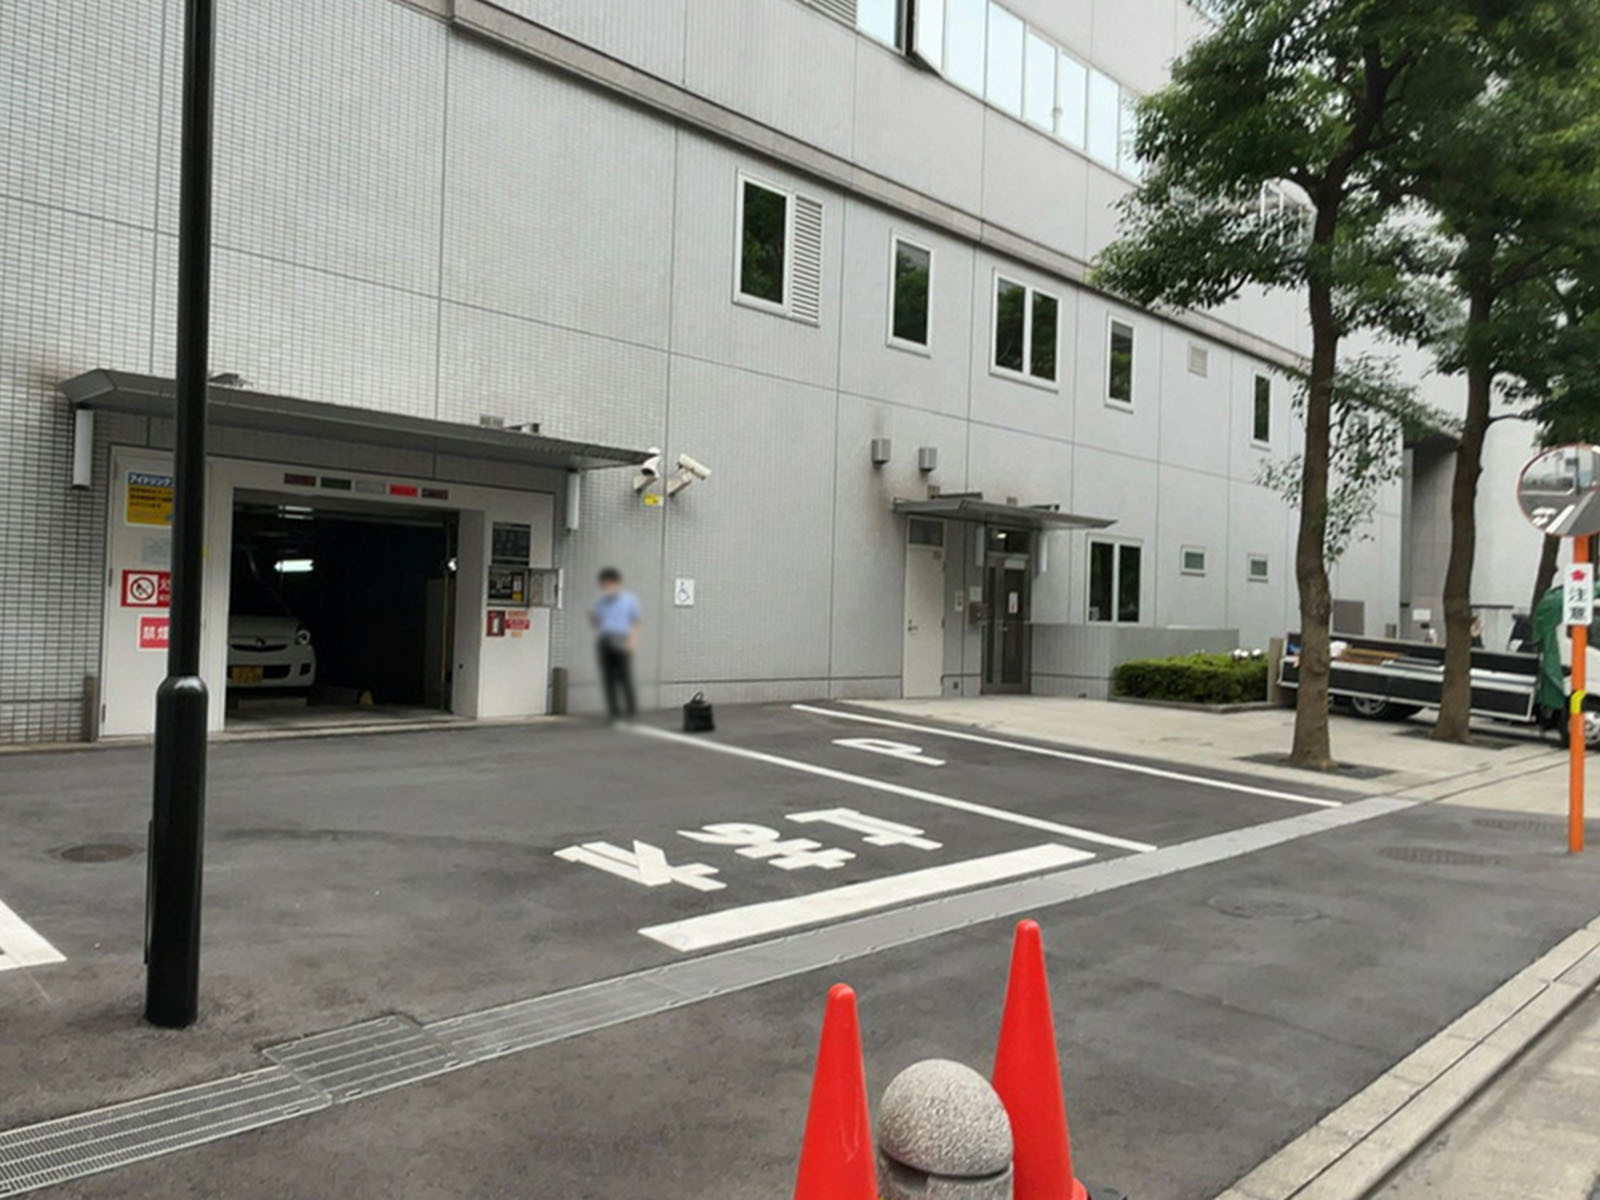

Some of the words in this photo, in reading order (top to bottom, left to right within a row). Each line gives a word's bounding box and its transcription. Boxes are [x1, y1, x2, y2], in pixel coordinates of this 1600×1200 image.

[831, 738, 946, 766] P
[554, 807, 943, 892] 止まれ
